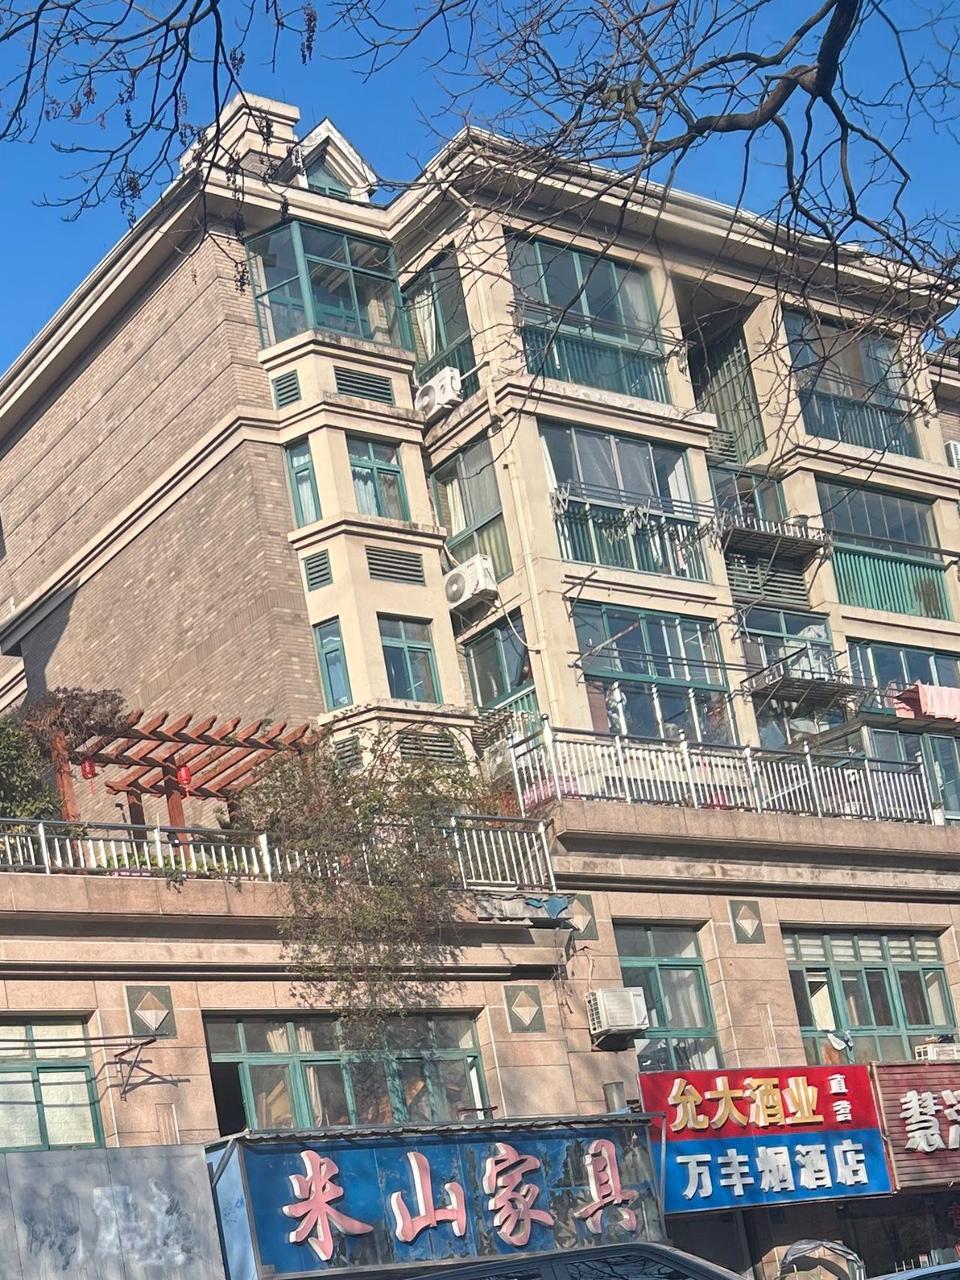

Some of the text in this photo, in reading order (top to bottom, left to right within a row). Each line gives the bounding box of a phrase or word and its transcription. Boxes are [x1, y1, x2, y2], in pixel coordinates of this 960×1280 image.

[667, 1075, 824, 1132] 允大酒业
[828, 1074, 853, 1123] 直营
[676, 1139, 869, 1200] 万丰烟酒店
[282, 1138, 639, 1262] 米山家具
